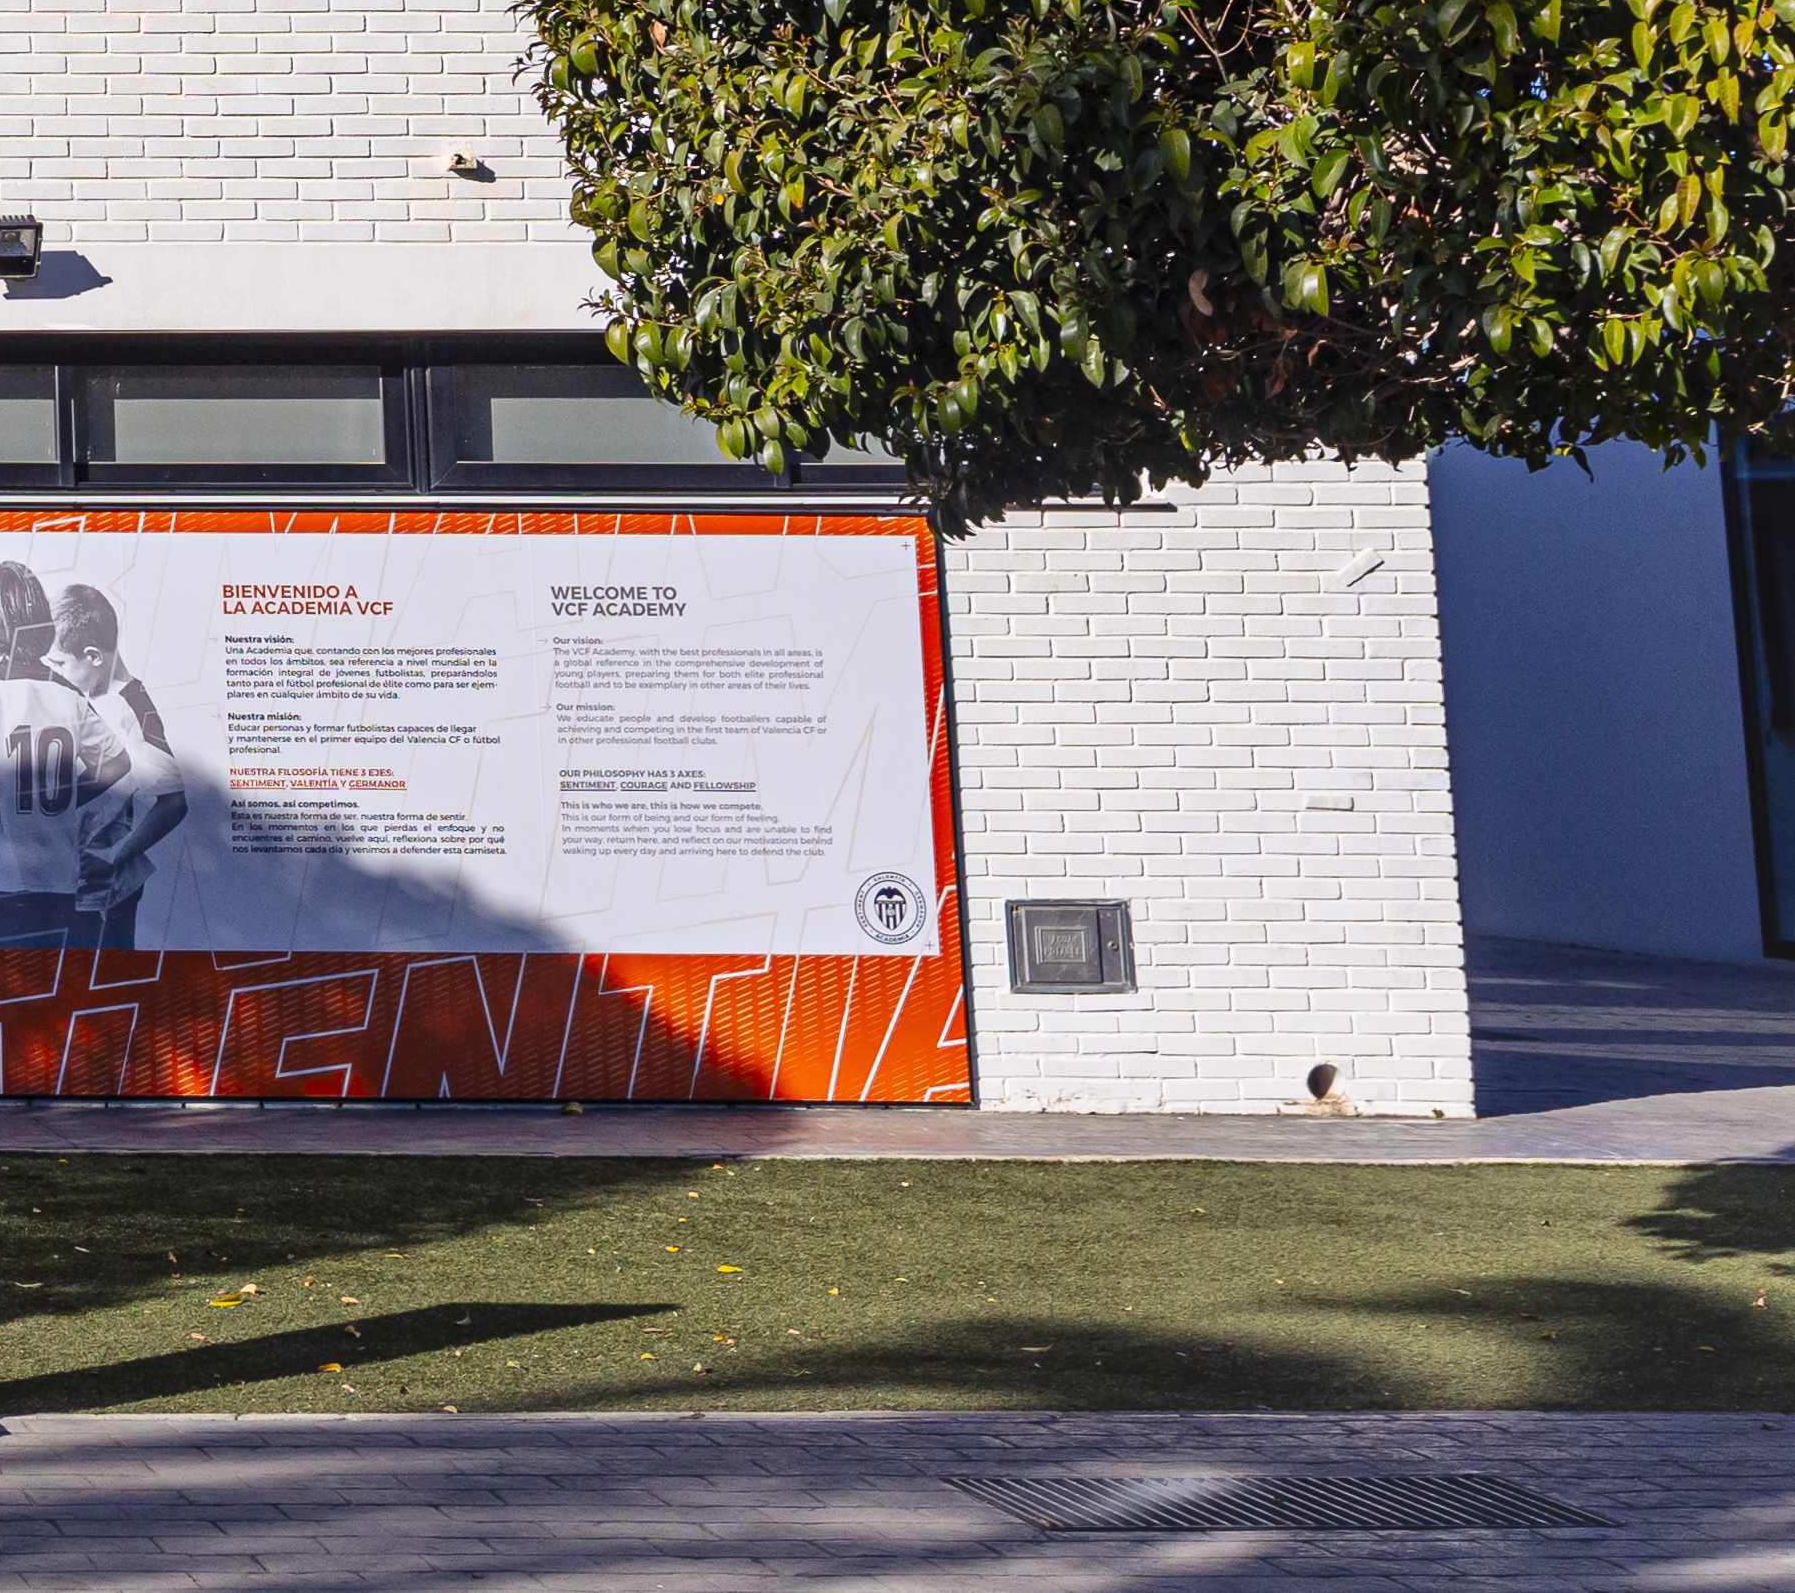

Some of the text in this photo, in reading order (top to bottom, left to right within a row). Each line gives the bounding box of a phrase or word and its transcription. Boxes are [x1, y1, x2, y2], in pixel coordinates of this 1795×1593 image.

[223, 585, 358, 599] BIENVENIDO A
[551, 586, 676, 600] WELCOME TO
[223, 601, 393, 615] LA ACADEMIA VCF
[551, 602, 686, 616] VCF ACADEMY
[264, 635, 294, 643] visión:
[267, 712, 301, 720] misión:
[5, 724, 76, 815] 10
[230, 768, 276, 776] NUESTRA
[278, 767, 328, 776] FILOSOFÍA
[583, 770, 645, 778] PHILOSOPHY
[670, 770, 675, 778] 3
[678, 770, 706, 778] AXES:
[560, 781, 618, 790] SENTIMENT,
[620, 781, 667, 790] COURAGE
